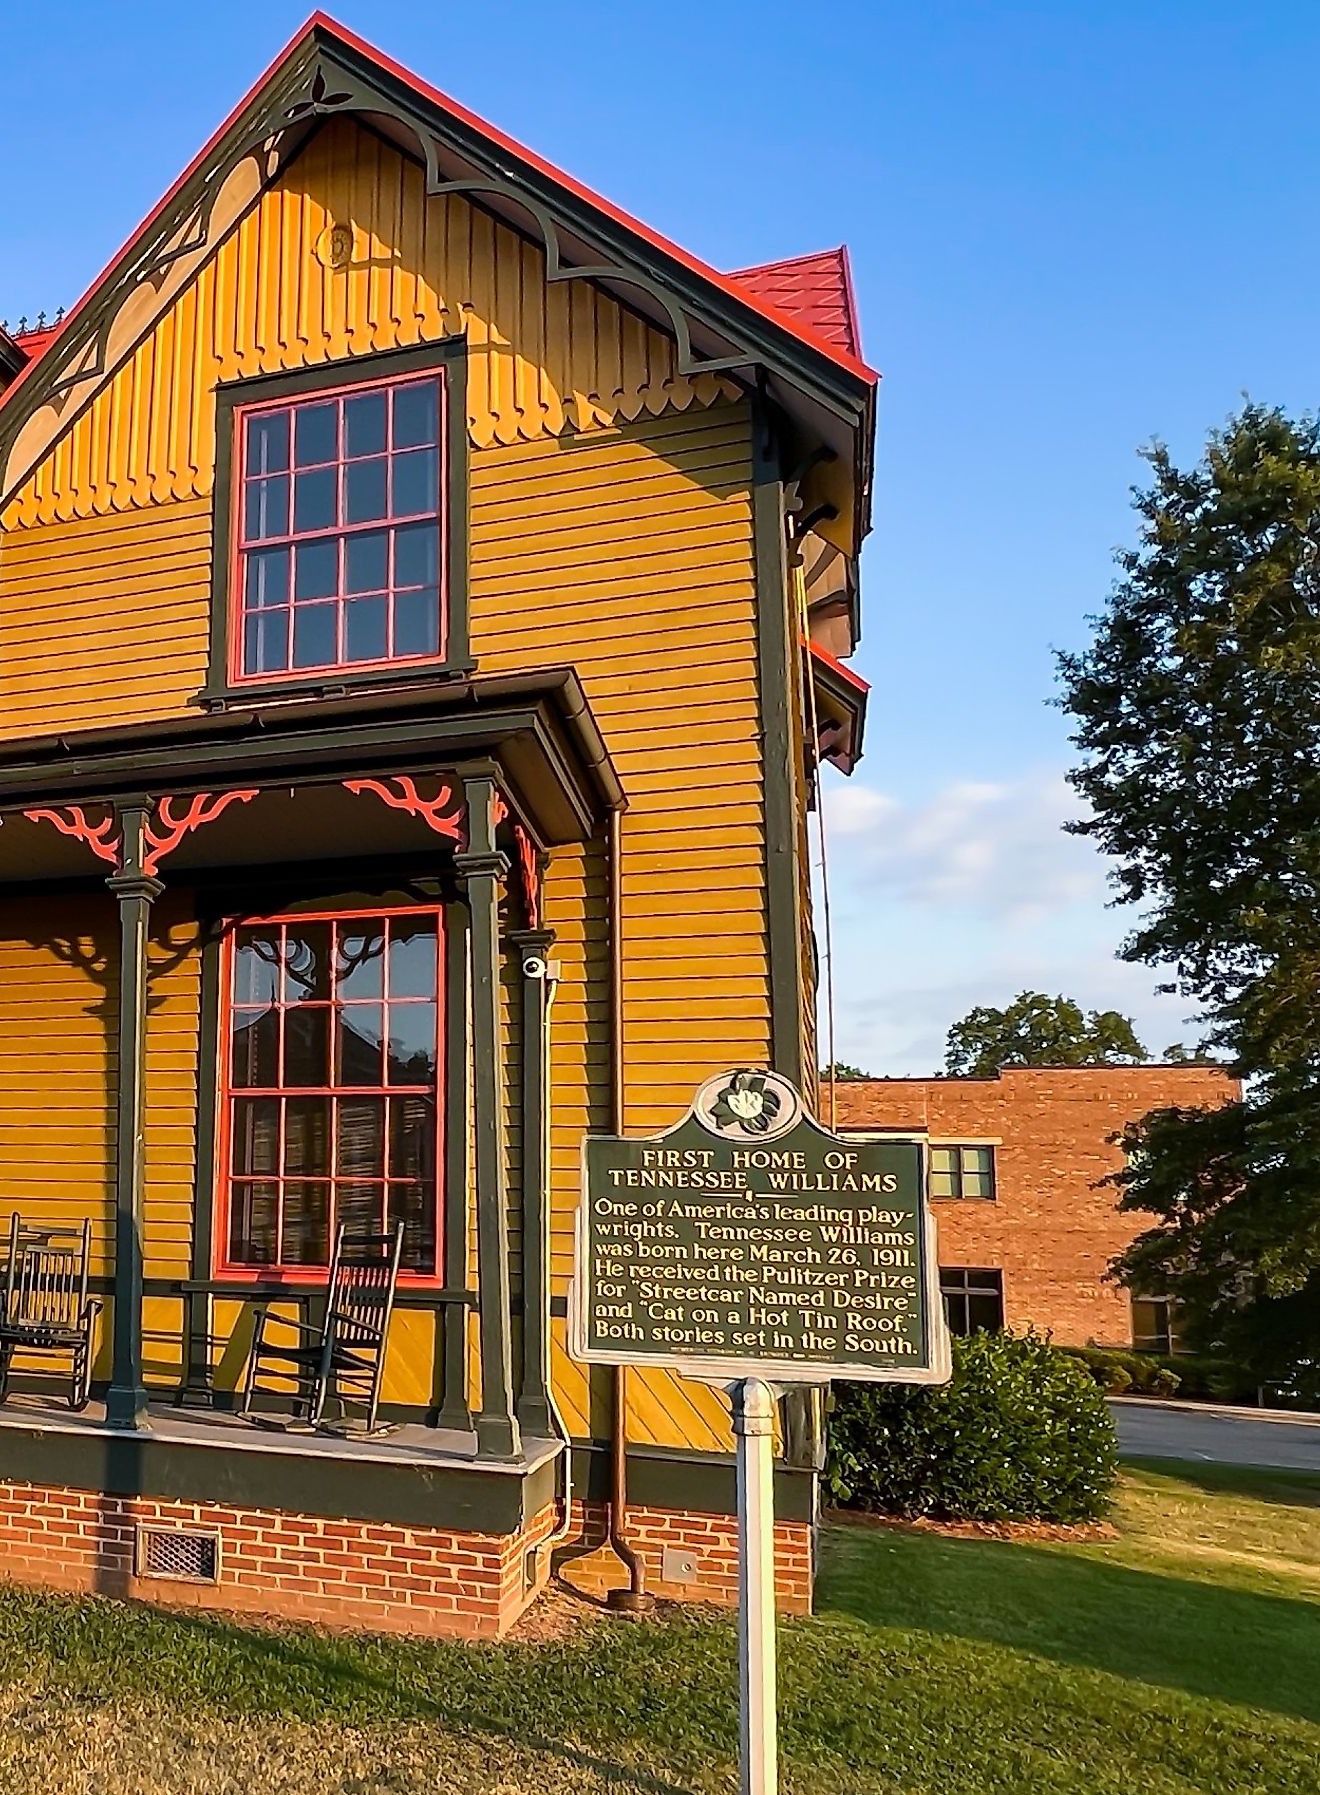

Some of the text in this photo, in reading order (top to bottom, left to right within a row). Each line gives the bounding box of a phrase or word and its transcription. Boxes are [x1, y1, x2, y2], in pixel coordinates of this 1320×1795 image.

[642, 1150, 859, 1170] FIRST HOME OF
[608, 1169, 898, 1192] TENNESSEE WILLIAMS
[594, 1197, 915, 1228] One of America's leading play-
[694, 1221, 812, 1242] Tennessee
[819, 1225, 915, 1245] Williams
[595, 1243, 634, 1257] was
[638, 1241, 688, 1258] born
[693, 1243, 744, 1261] here
[749, 1244, 821, 1262] March
[872, 1249, 916, 1267] 1911.
[595, 1259, 916, 1289] He received the Pulitzer Prize
[595, 1280, 626, 1297] for
[748, 1286, 825, 1307] Named
[595, 1302, 633, 1318] and
[691, 1309, 719, 1323] on
[727, 1310, 741, 1324] a
[749, 1307, 789, 1326] Hot
[798, 1310, 838, 1329] Tin
[595, 1320, 645, 1340] Both
[651, 1326, 725, 1344] stories
[732, 1329, 766, 1346] set
[773, 1331, 794, 1348] in
[800, 1331, 837, 1350] the
[844, 1333, 918, 1354] South.
